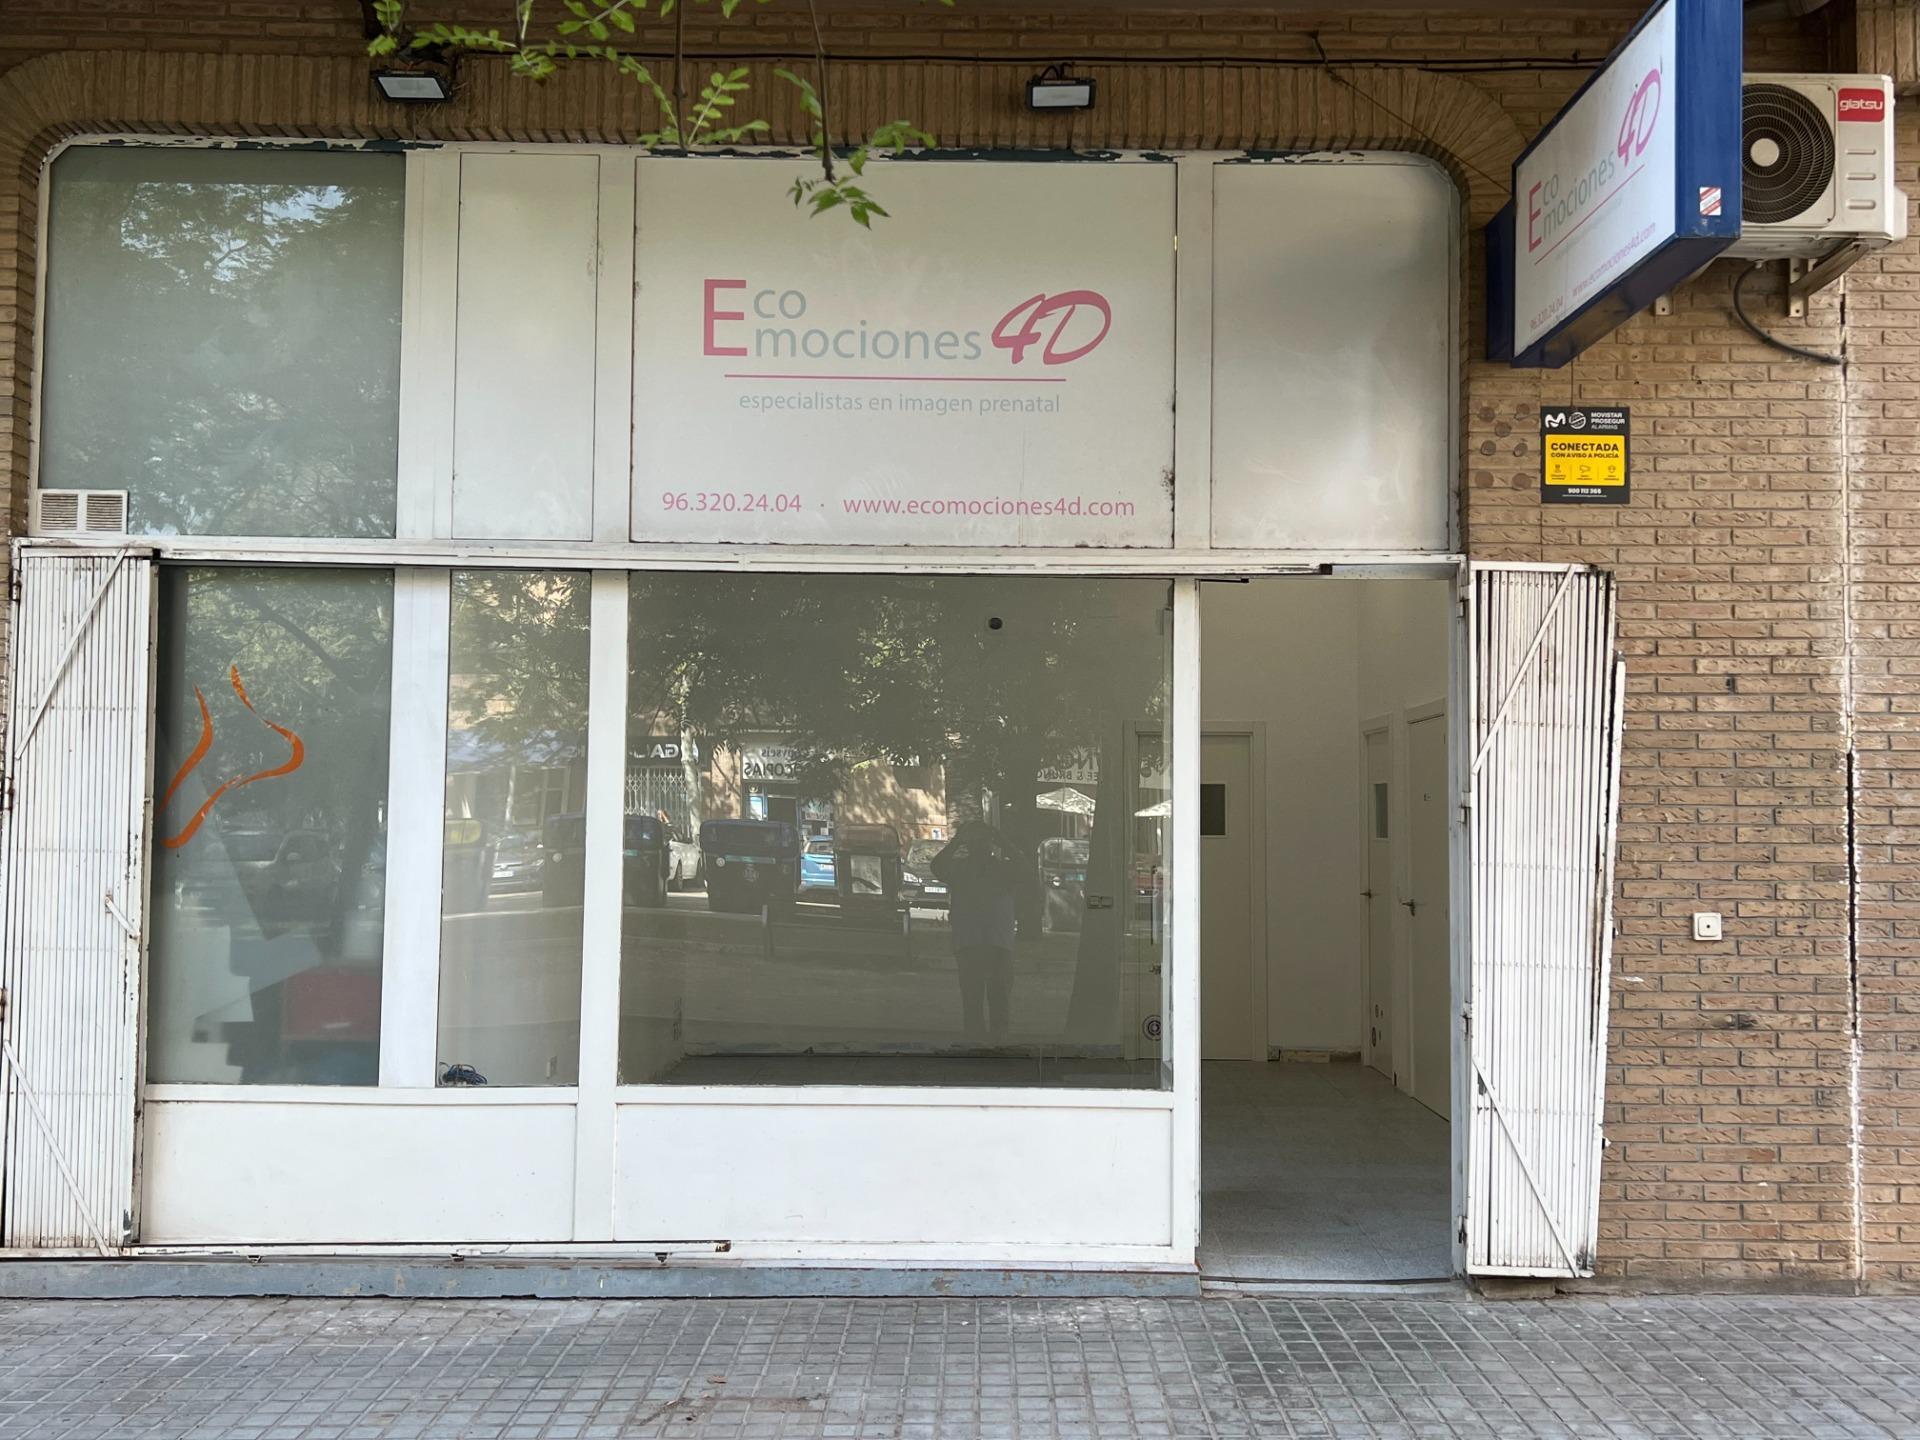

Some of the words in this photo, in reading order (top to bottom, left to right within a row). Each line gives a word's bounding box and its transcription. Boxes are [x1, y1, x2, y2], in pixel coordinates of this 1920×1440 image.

[1840, 99, 1883, 111] giatsu
[1617, 68, 1661, 167] 4D
[991, 290, 1112, 365] 4D
[739, 391, 862, 411] especialistas
[869, 396, 892, 411] en
[900, 392, 972, 416] imagen
[979, 394, 1060, 416] prenatal
[1551, 442, 1619, 452] CONECTADA
[662, 492, 802, 512] 96.320.24.04
[843, 496, 1135, 516] www.ecomociones4d.com
